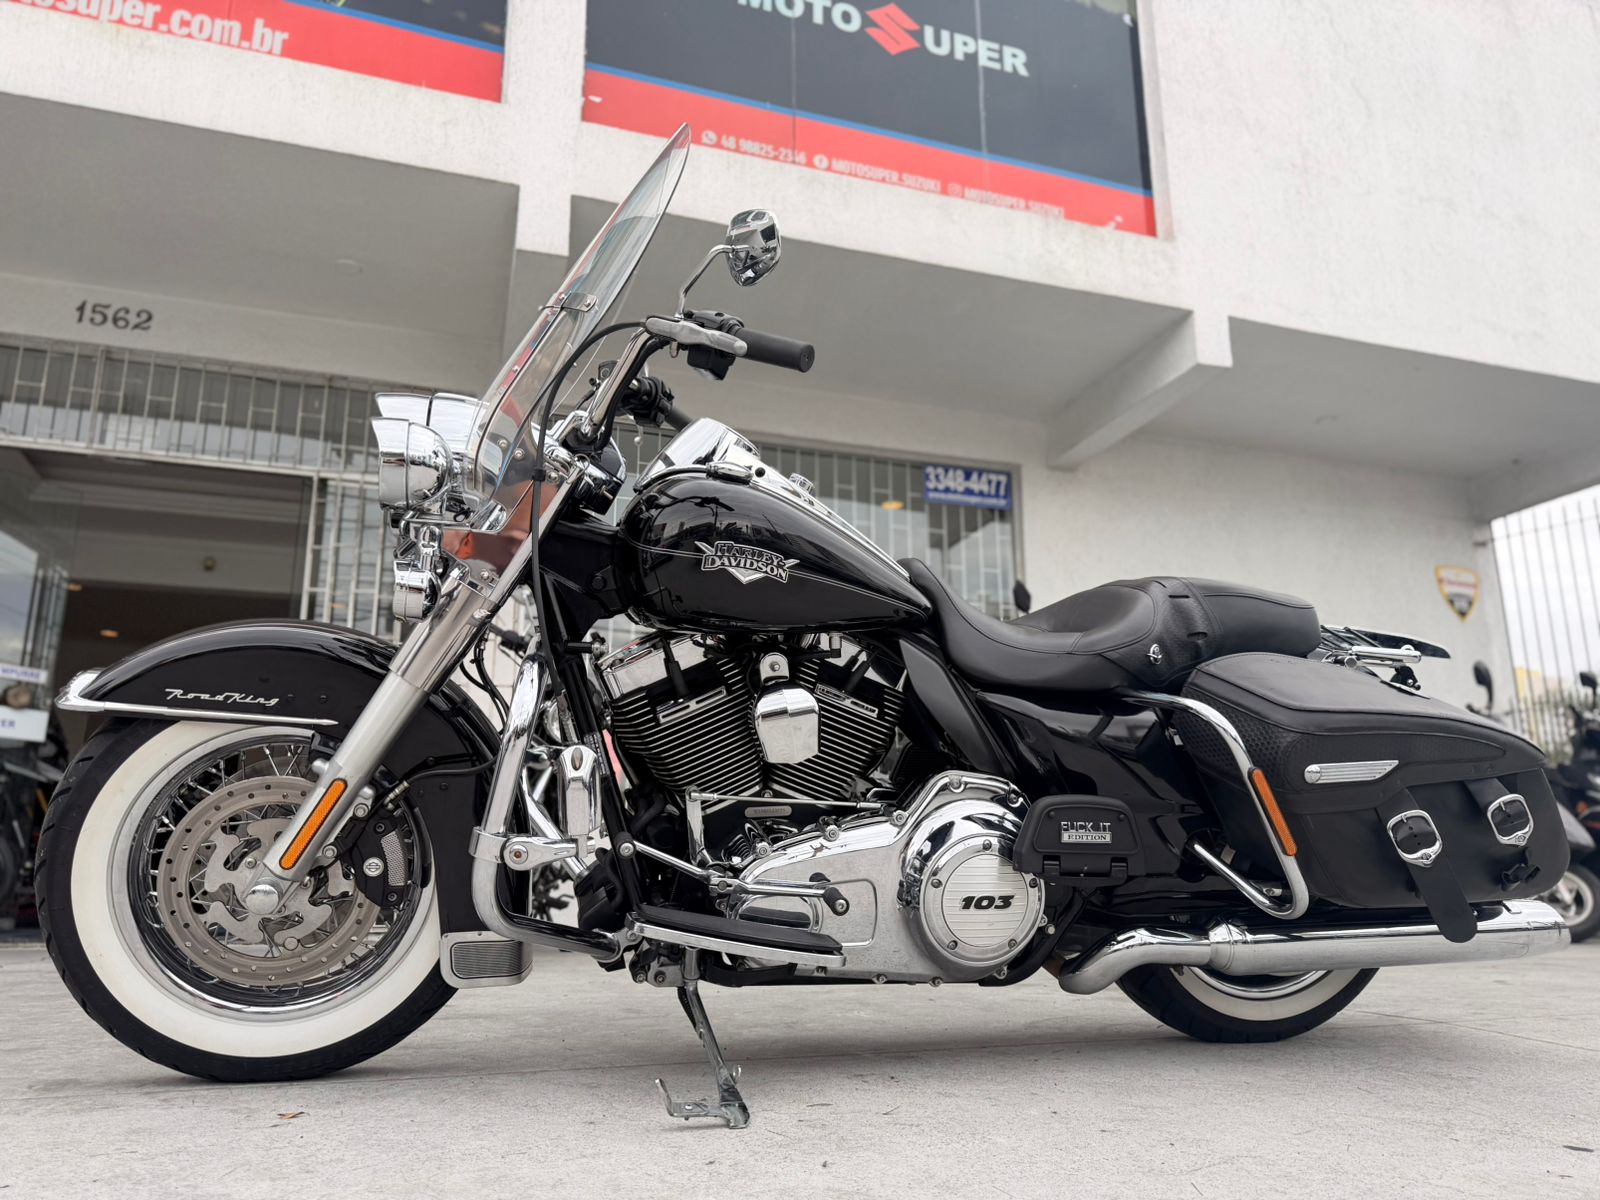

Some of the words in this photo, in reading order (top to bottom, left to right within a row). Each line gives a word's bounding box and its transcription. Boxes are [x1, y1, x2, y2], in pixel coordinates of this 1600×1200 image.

[20, 0, 289, 56] uper.com.br
[75, 299, 153, 331] 1562
[704, 555, 788, 580] DAVIDSON
[1060, 821, 1094, 833] FUCK
[1099, 822, 1112, 833] IT
[961, 894, 1016, 910] 103
